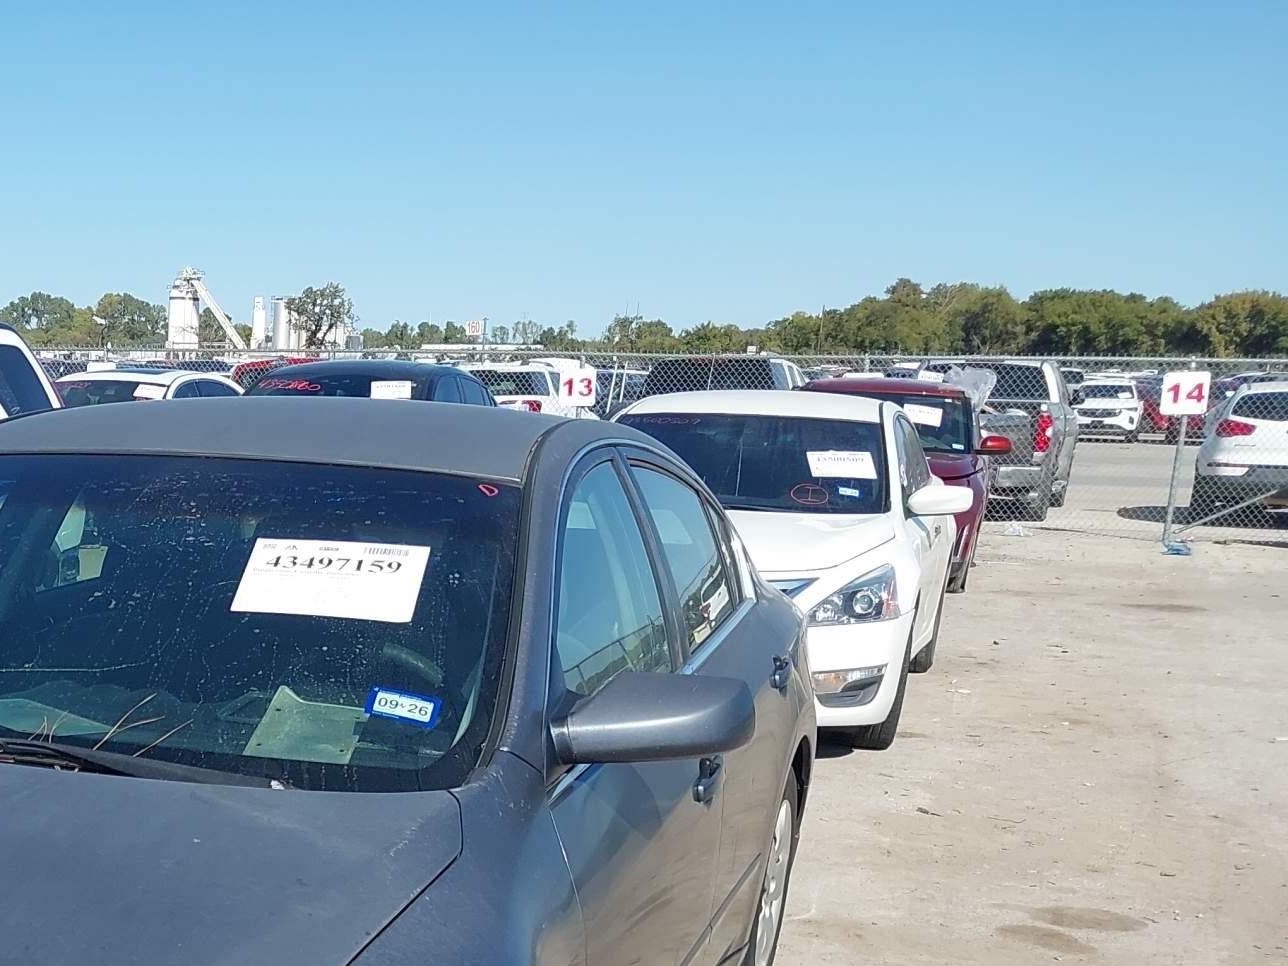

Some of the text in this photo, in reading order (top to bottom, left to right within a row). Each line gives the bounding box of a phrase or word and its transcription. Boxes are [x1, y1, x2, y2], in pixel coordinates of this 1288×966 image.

[563, 377, 593, 397] 13
[1167, 382, 1205, 404] 14
[266, 555, 403, 574] 43497159
